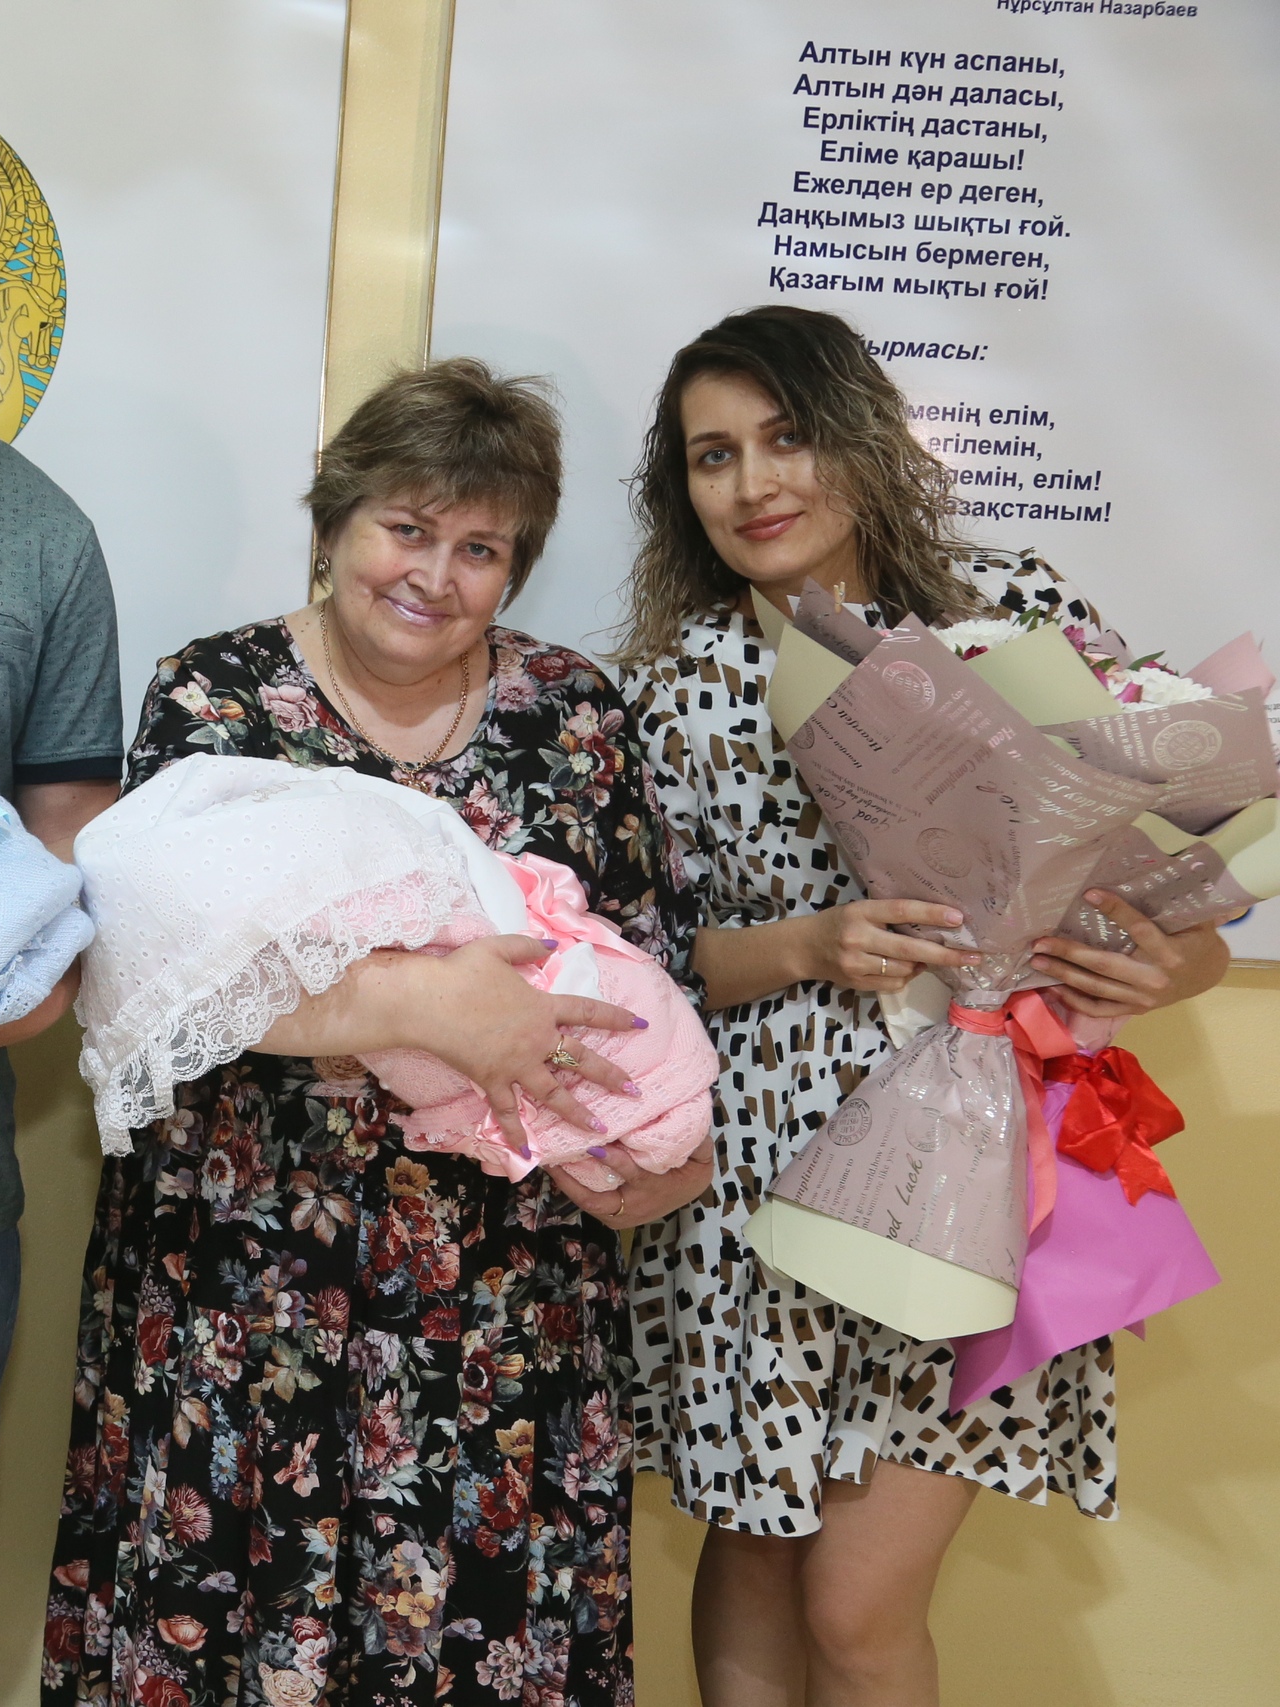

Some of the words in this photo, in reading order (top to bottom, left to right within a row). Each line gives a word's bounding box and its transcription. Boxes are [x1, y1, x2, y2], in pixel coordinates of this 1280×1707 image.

[1099, 0, 1198, 20] Назарбаев
[798, 40, 892, 67] Алтын
[899, 50, 946, 74] күн
[953, 53, 1065, 79] аспаны,
[792, 73, 886, 100] Алтын
[891, 83, 944, 105] дән
[949, 86, 1064, 112] даласы,
[802, 105, 915, 138] Ерліктің
[920, 117, 1048, 144] дастаны,
[819, 139, 899, 165] Еліме
[907, 148, 1025, 173] қарашы!
[793, 170, 913, 201] Ежелден
[920, 182, 953, 205] ер
[958, 184, 1044, 209] деген,
[757, 201, 906, 230] Даңқымыз
[913, 214, 1011, 237] шықты
[1018, 214, 1071, 238] ғой.
[773, 234, 908, 262] Намысын
[915, 240, 1050, 273] бермеген,
[769, 265, 885, 293] Қазағым
[892, 277, 987, 300] мықты
[993, 277, 1049, 301] ғой!
[907, 402, 981, 427] менің
[989, 405, 1055, 429] елім,
[928, 433, 1042, 461] егілемін,
[1033, 470, 1101, 491] елім!
[937, 497, 1111, 522] азақстаным!
[829, 1166, 851, 1207] springtime
[845, 1157, 854, 1167] to
[877, 1163, 890, 1179] like
[894, 1152, 924, 1205] Luck
